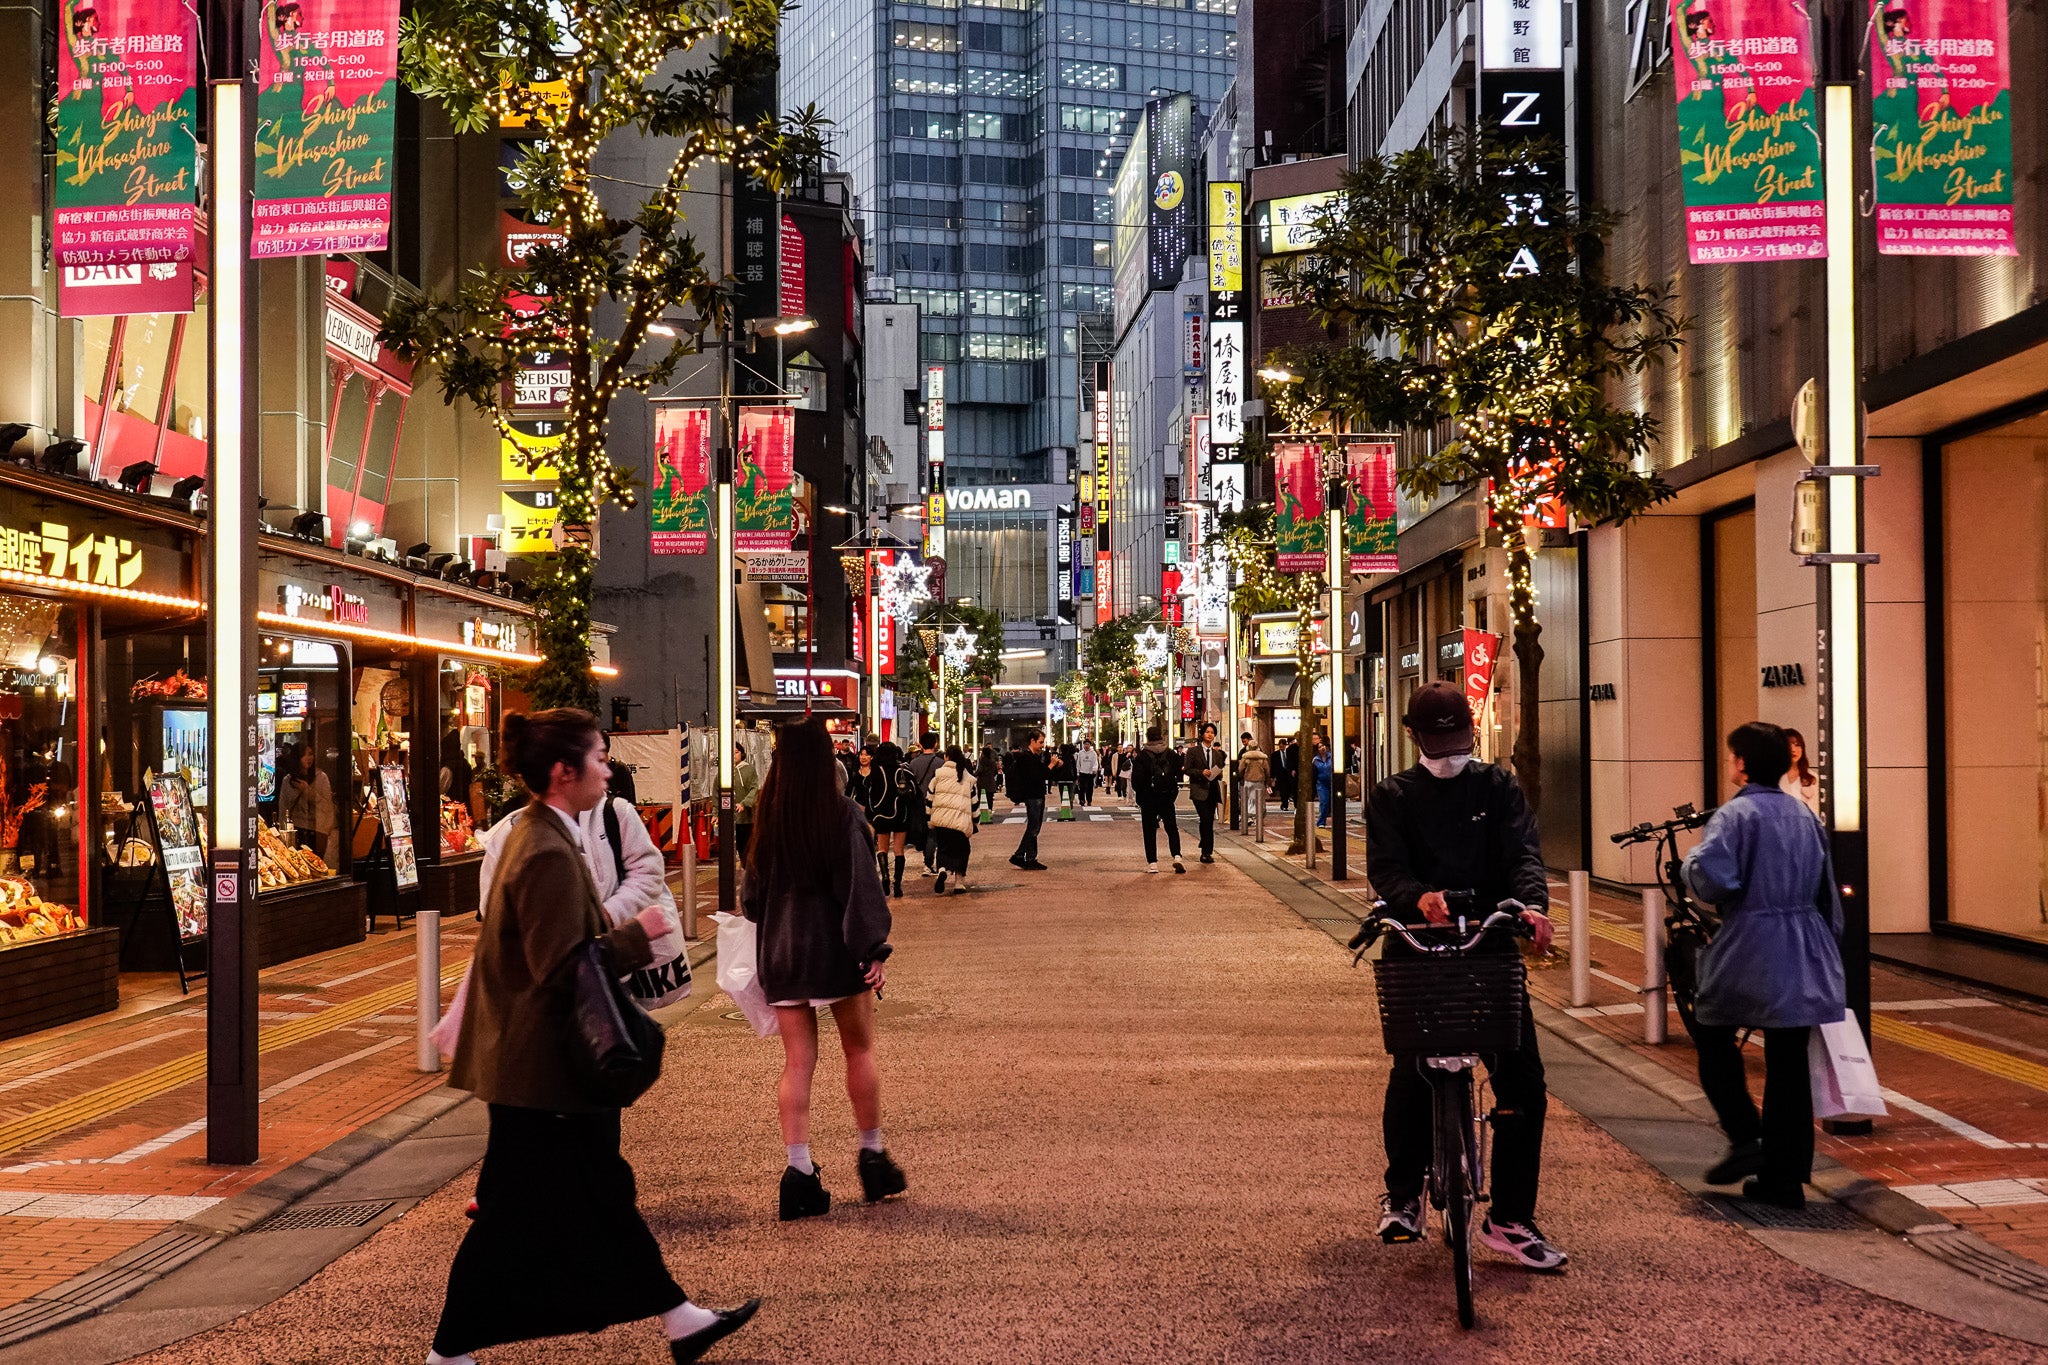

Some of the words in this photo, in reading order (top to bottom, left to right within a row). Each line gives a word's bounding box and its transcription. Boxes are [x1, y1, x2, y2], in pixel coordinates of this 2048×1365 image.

[73, 34, 183, 57] 歩行者用道路
[275, 29, 385, 51] 歩行者用道路
[1688, 36, 1799, 59] 歩行者用道路
[1885, 38, 1996, 58] 歩行者用道路
[102, 97, 189, 142] Shinjuku
[302, 90, 388, 135] Shinjuku
[1725, 98, 1809, 142] Shinjuku
[1920, 101, 2003, 142] Shinjuku
[124, 165, 190, 206] Street
[322, 157, 387, 198] Street
[1754, 164, 1815, 204] Street
[1943, 167, 2006, 206] Street
[57, 207, 192, 225] 新宿東口商店街振興組合
[257, 197, 388, 217] 新宿東口商店街振興組合
[1689, 205, 1824, 223] 新宿東口商店街振興組合
[1879, 208, 2011, 222] 新宿東口商店街振興組合
[62, 231, 86, 244] 協力
[90, 226, 189, 243] 新宿武蔵野商栄会
[260, 224, 284, 235] 協力
[287, 217, 384, 234] 新宿武蔵野商栄会
[1259, 214, 1270, 243] 4F
[1695, 229, 1720, 242] 協力
[1723, 223, 1822, 242] 新宿武蔵野商栄会
[1883, 228, 1909, 240] 協力
[1911, 227, 2008, 241] 新宿武蔵野商栄会
[257, 234, 364, 254] 防犯カメラ作動中
[746, 217, 764, 282] 補聴器
[1696, 242, 1806, 259] 防犯カメラ作動中
[63, 247, 172, 264] 防犯カメラ作動中
[73, 264, 134, 280] BAR
[1218, 291, 1234, 302] 4F
[1215, 305, 1238, 318] 4F
[327, 314, 354, 348] YEBISU
[354, 328, 372, 358] BAR
[535, 352, 551, 364] 2F
[518, 388, 547, 401] BAR
[536, 421, 552, 435] 1F
[1216, 447, 1240, 461] 3F
[536, 493, 553, 507] B1
[1058, 518, 1070, 563] PASELABO
[0, 522, 143, 588] 銀座ライオン
[748, 558, 806, 567] つるかめクリニック
[1058, 570, 1071, 601] TOWER
[331, 585, 368, 623] BLUMARE
[1761, 663, 1805, 687] ZARA
[1589, 683, 1616, 701] ZARA
[248, 694, 257, 900] 新宿武蔵野通り
